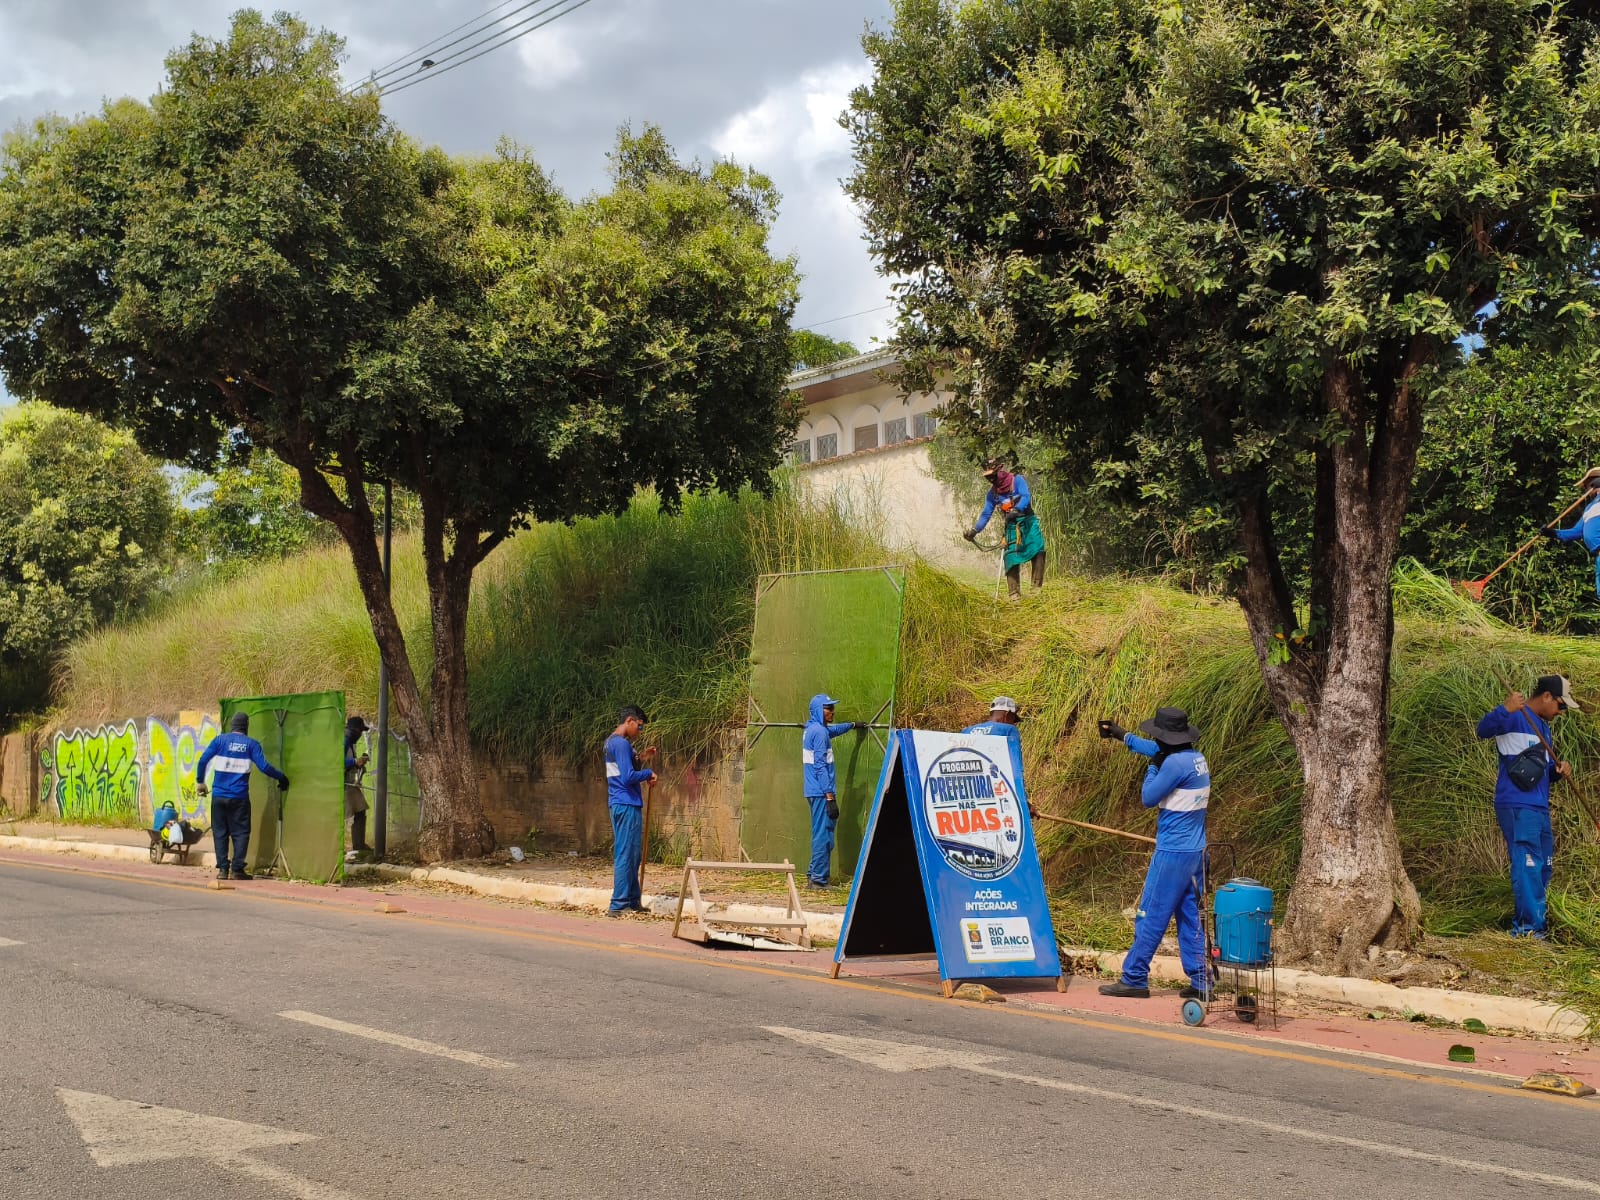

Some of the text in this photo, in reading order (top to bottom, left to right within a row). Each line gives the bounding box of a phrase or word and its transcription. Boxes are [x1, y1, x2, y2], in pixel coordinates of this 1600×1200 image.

[941, 761, 981, 772] PROGRAMA
[929, 775, 995, 803] PREFEITURA
[958, 802, 976, 810] NAS
[935, 807, 1001, 836] RUAS
[974, 887, 1002, 902] AÇÕES
[965, 902, 1018, 911] INTEGRADAS
[988, 927, 1004, 936] RIO
[990, 935, 1030, 946] BRANCO
